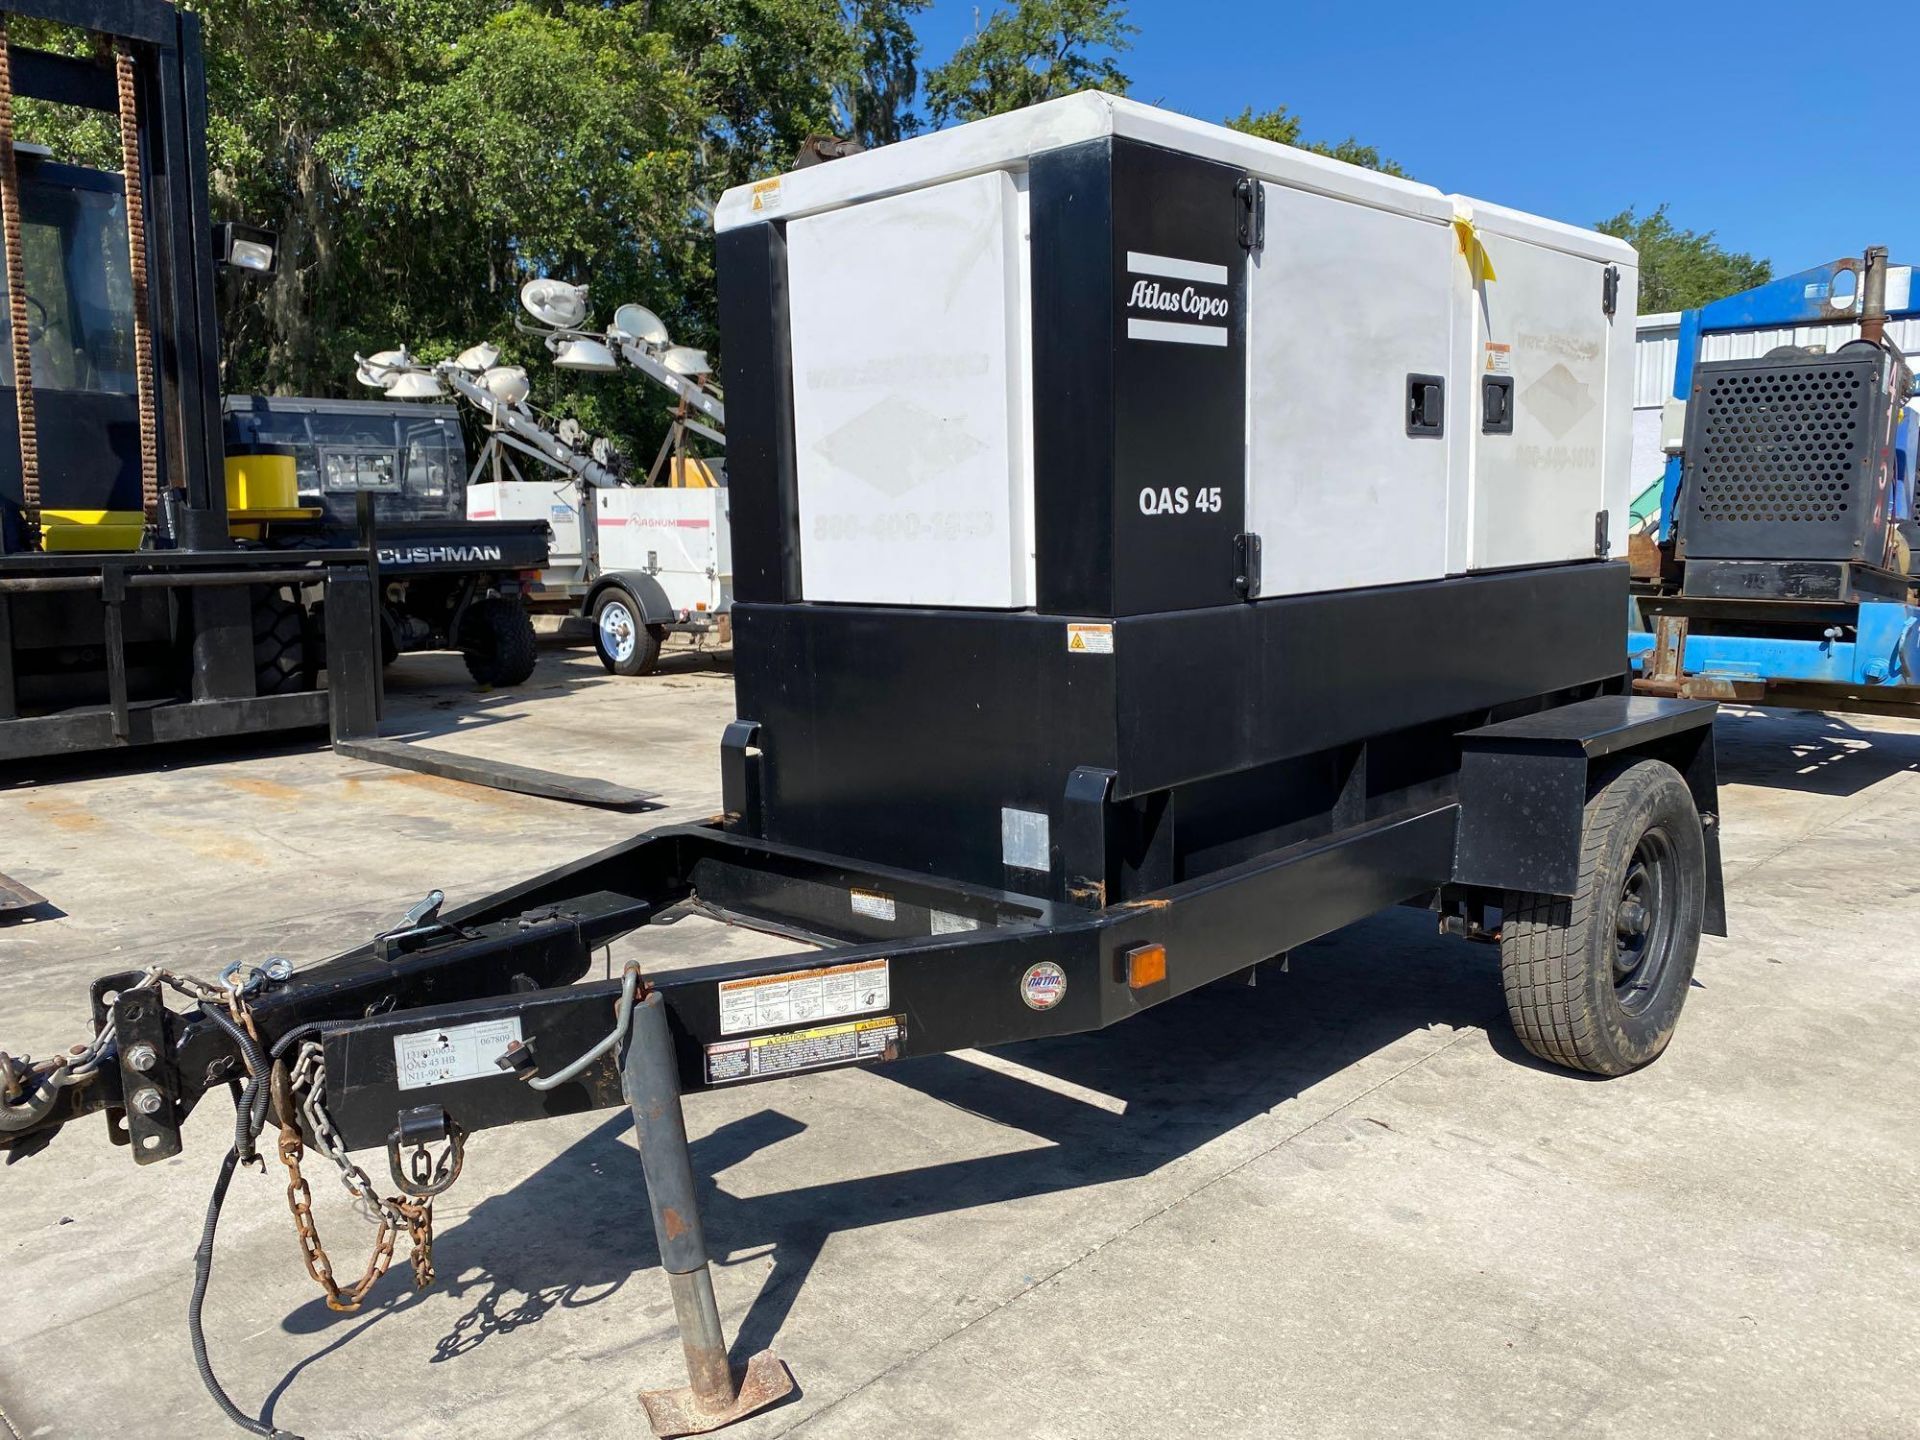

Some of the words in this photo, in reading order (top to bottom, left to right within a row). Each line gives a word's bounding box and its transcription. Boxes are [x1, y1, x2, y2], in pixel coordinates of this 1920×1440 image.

[1127, 280, 1180, 312] Atlas
[1181, 286, 1229, 320] Copco
[1139, 486, 1189, 515] QAS
[1195, 487, 1222, 513] 45
[377, 545, 501, 564] CUSHMAN
[867, 1017, 896, 1029] WARNIN
[774, 1033, 807, 1044] CAUTION
[406, 1059, 427, 1071] QAS
